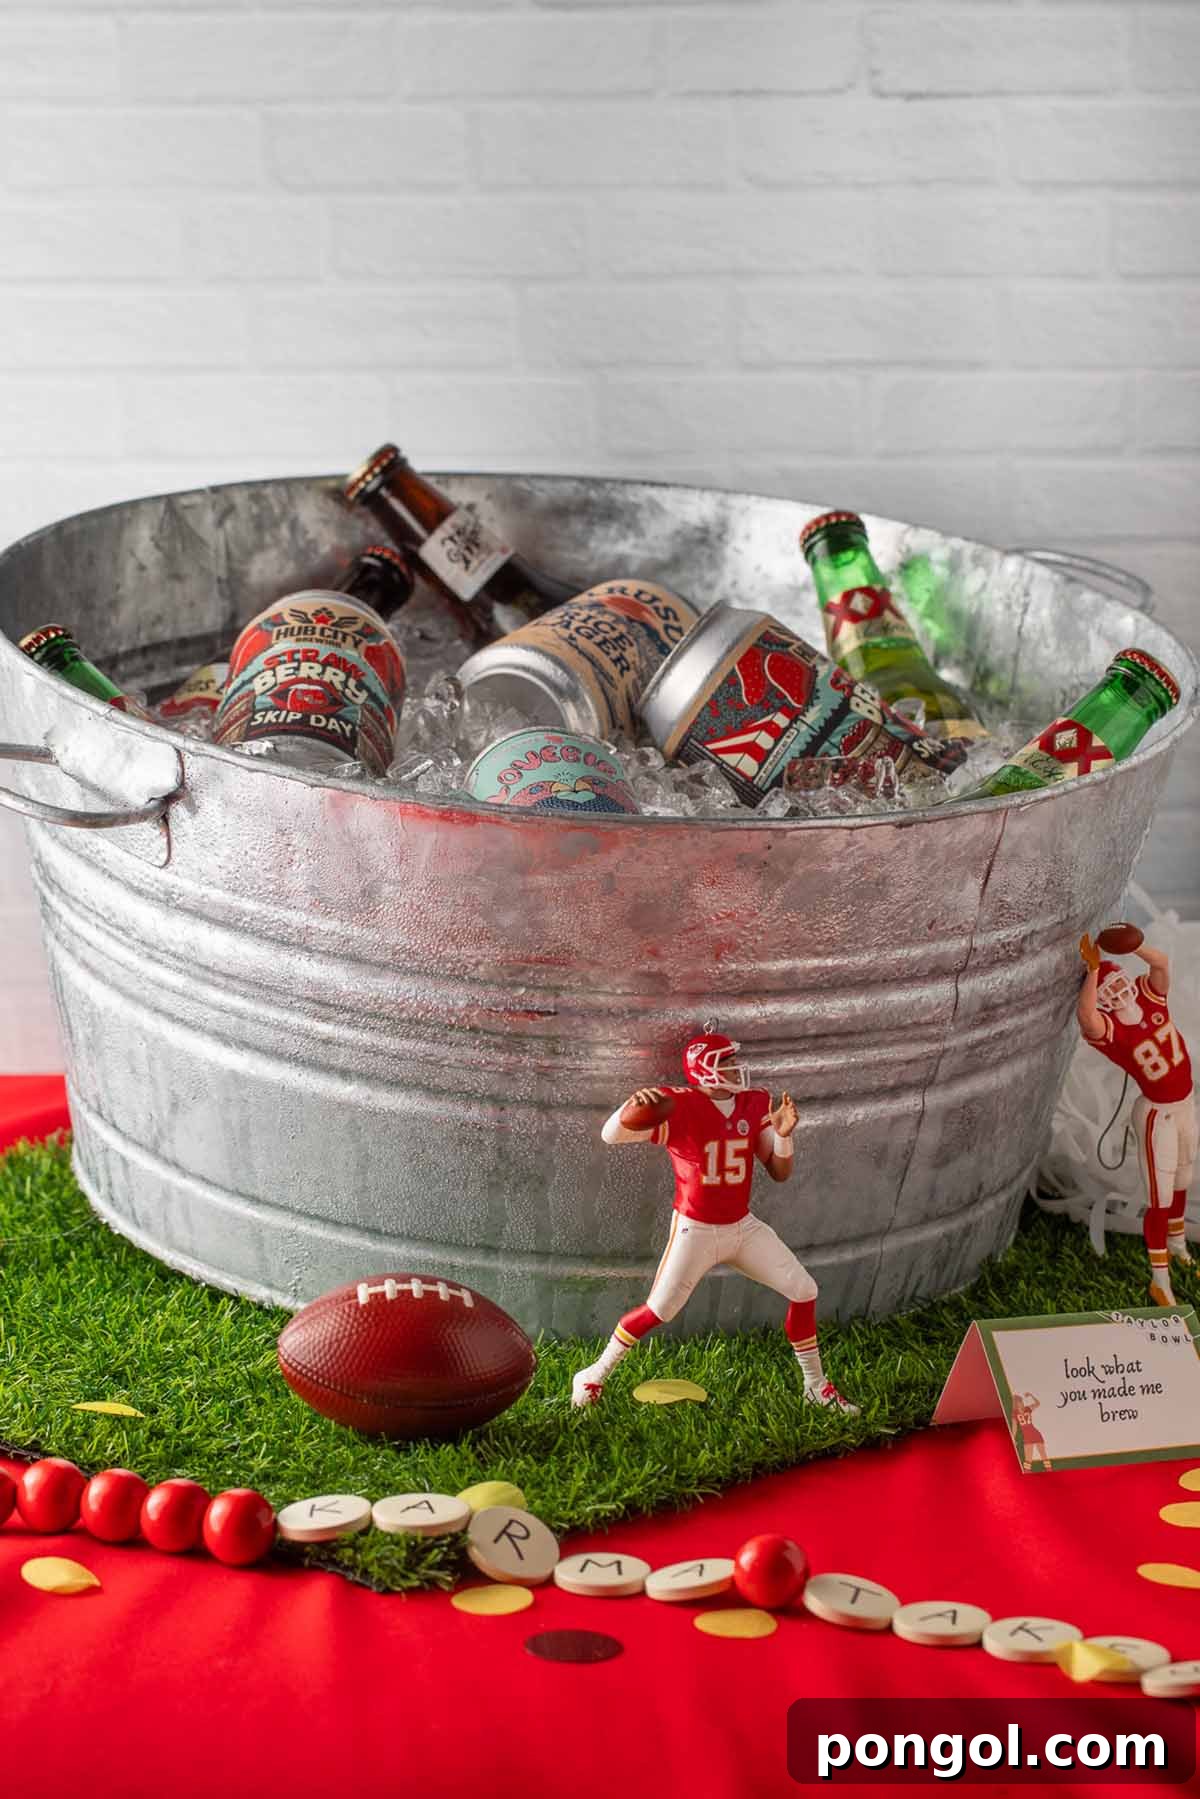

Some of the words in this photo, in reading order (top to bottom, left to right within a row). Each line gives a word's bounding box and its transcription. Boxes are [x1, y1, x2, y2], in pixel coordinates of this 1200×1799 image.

[275, 624, 317, 641] HUB
[319, 626, 365, 648] CITY
[263, 648, 368, 681] STRAW
[253, 661, 368, 705] BERRY
[250, 710, 302, 726] SKIP
[309, 714, 353, 738] DAY
[1132, 1022, 1185, 1082] 87
[701, 1137, 750, 1186] 15
[1113, 1312, 1181, 1329] TAYLOR
[1149, 1332, 1192, 1345] BOWL
[1063, 1356, 1106, 1383] look
[1101, 1353, 1143, 1376] what
[1056, 1388, 1087, 1409] you
[1091, 1376, 1136, 1400] made
[1139, 1382, 1164, 1395] me
[1098, 1401, 1139, 1423] brew
